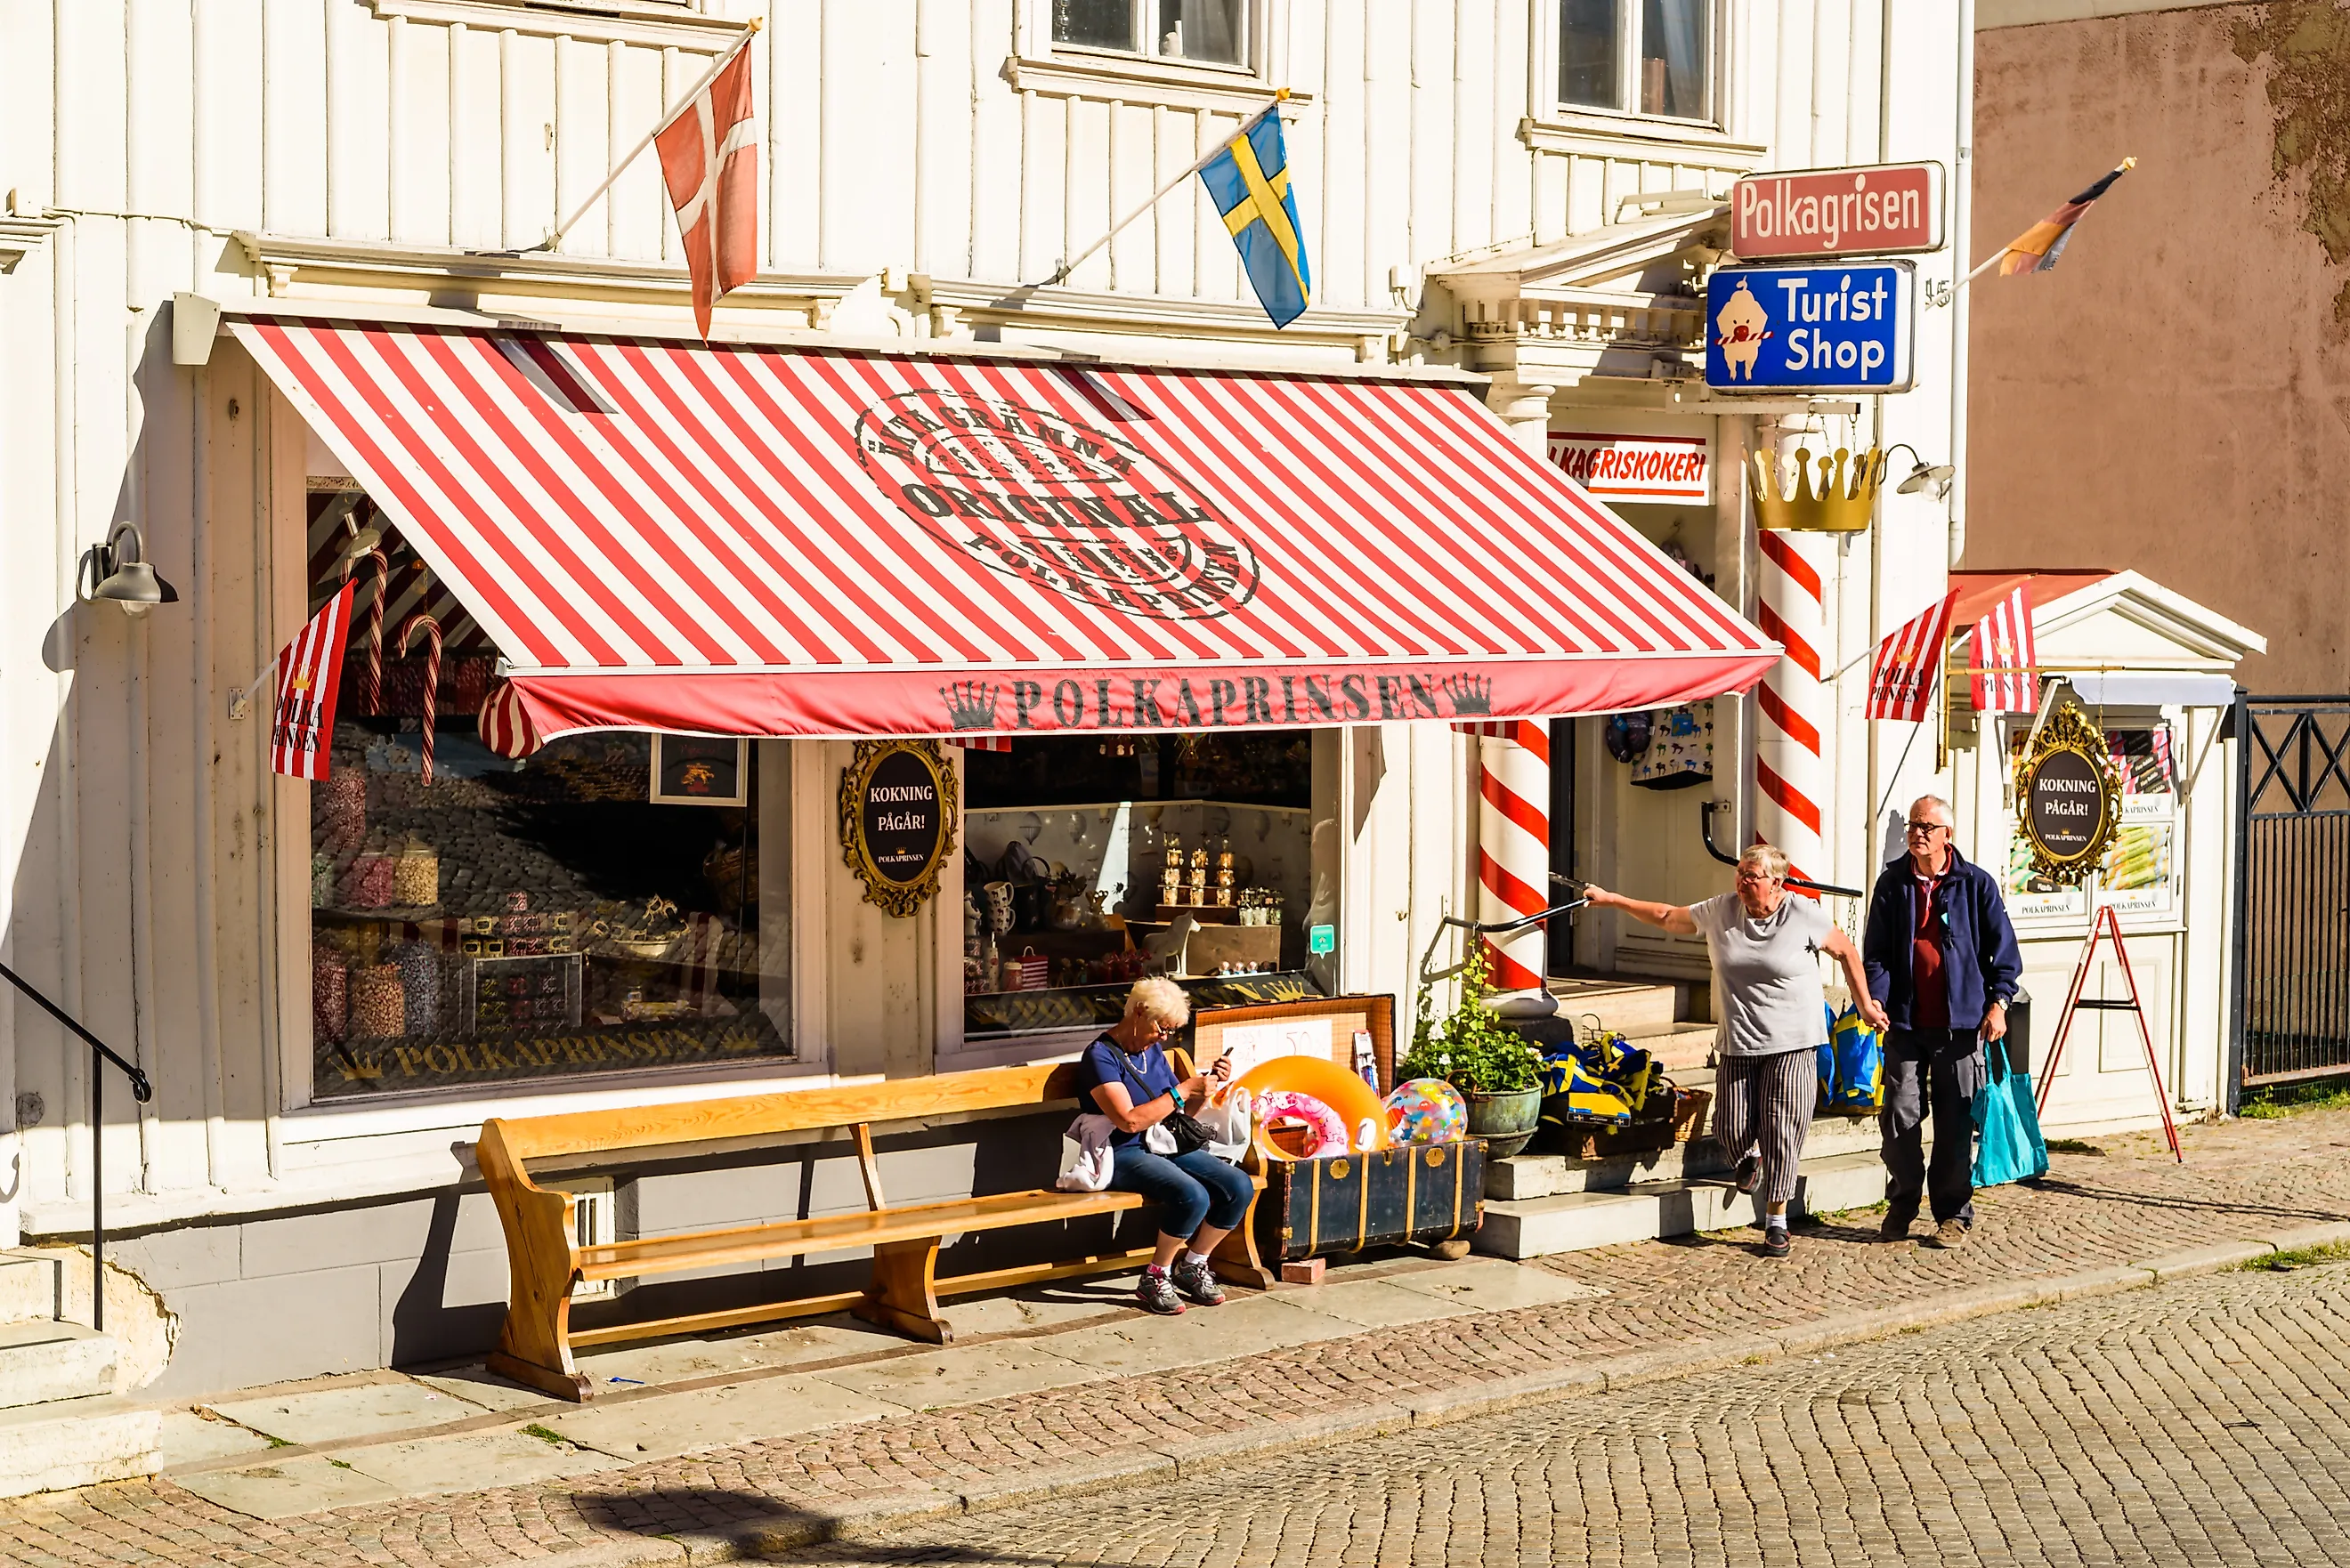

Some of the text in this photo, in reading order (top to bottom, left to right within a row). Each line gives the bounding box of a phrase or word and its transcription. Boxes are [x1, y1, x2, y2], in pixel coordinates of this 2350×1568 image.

[1740, 174, 1920, 249] Polkagrisen
[1778, 274, 1888, 322] Turist
[1785, 329, 1885, 381] Shop
[902, 483, 1216, 529] ORIGINAL
[963, 531, 1241, 612] POLKAPRINSEN
[1874, 667, 1925, 687] POLKA
[1013, 673, 1442, 729] POLKAPRINSEN
[1871, 686, 1923, 703] PRINSEN
[870, 785, 933, 804] KOKNING
[2038, 779, 2096, 794] KOKNING
[2045, 799, 2088, 816] PÅGÅR!
[878, 812, 926, 831] PÅGÅR!
[2045, 834, 2087, 842] POLKAPRINSEN
[878, 853, 925, 863] POLKAPRINSEN
[2022, 904, 2070, 914] POLKAPRINSEN
[393, 1028, 708, 1078] POLKAPRINSEN
